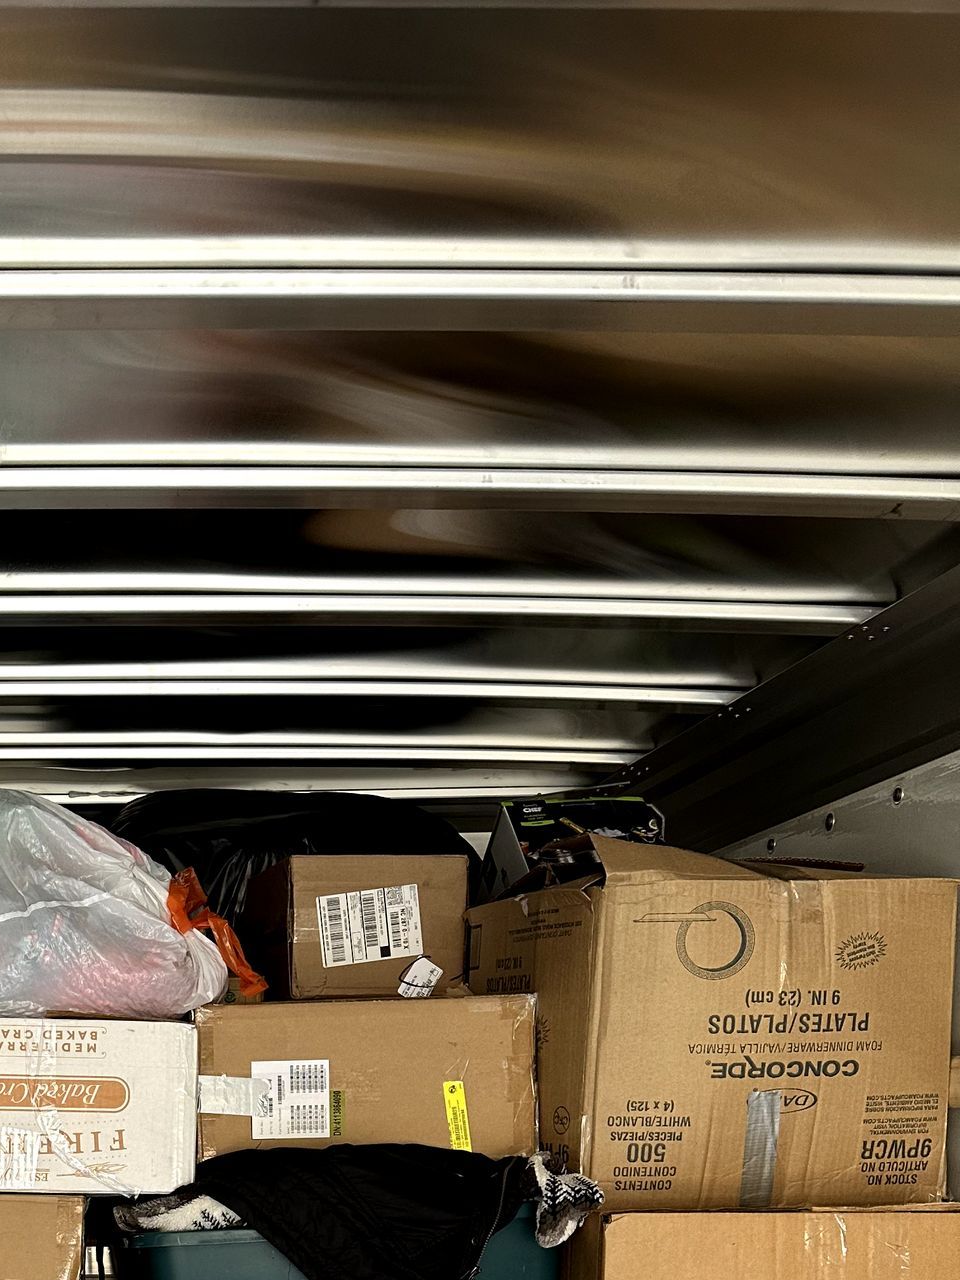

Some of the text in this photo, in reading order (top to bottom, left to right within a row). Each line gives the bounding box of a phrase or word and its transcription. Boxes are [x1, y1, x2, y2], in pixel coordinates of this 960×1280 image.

[745, 988, 840, 1008] 9 IN. (23 cm)
[708, 1012, 870, 1035] PLATES/PLATOS
[42, 1029, 98, 1041] BAKED
[688, 1040, 883, 1056] FOAM DINNERWARE/VAJILLA TÉRMICA
[710, 1055, 860, 1079] CONCORDE
[32, 1082, 101, 1105] Baked
[626, 1099, 675, 1113] (4 x 125)
[607, 1115, 691, 1127] WHITE/BLANCO
[610, 1131, 683, 1142] PIECES/PIEZAS
[626, 1142, 666, 1163] 500
[861, 1138, 932, 1160] 9PWCR
[613, 1166, 677, 1177] CONTENIDO
[859, 1160, 929, 1173] ARTÍCULO NO.
[615, 1179, 672, 1191] CONTENTS
[866, 1174, 918, 1186] STOCK NO.
